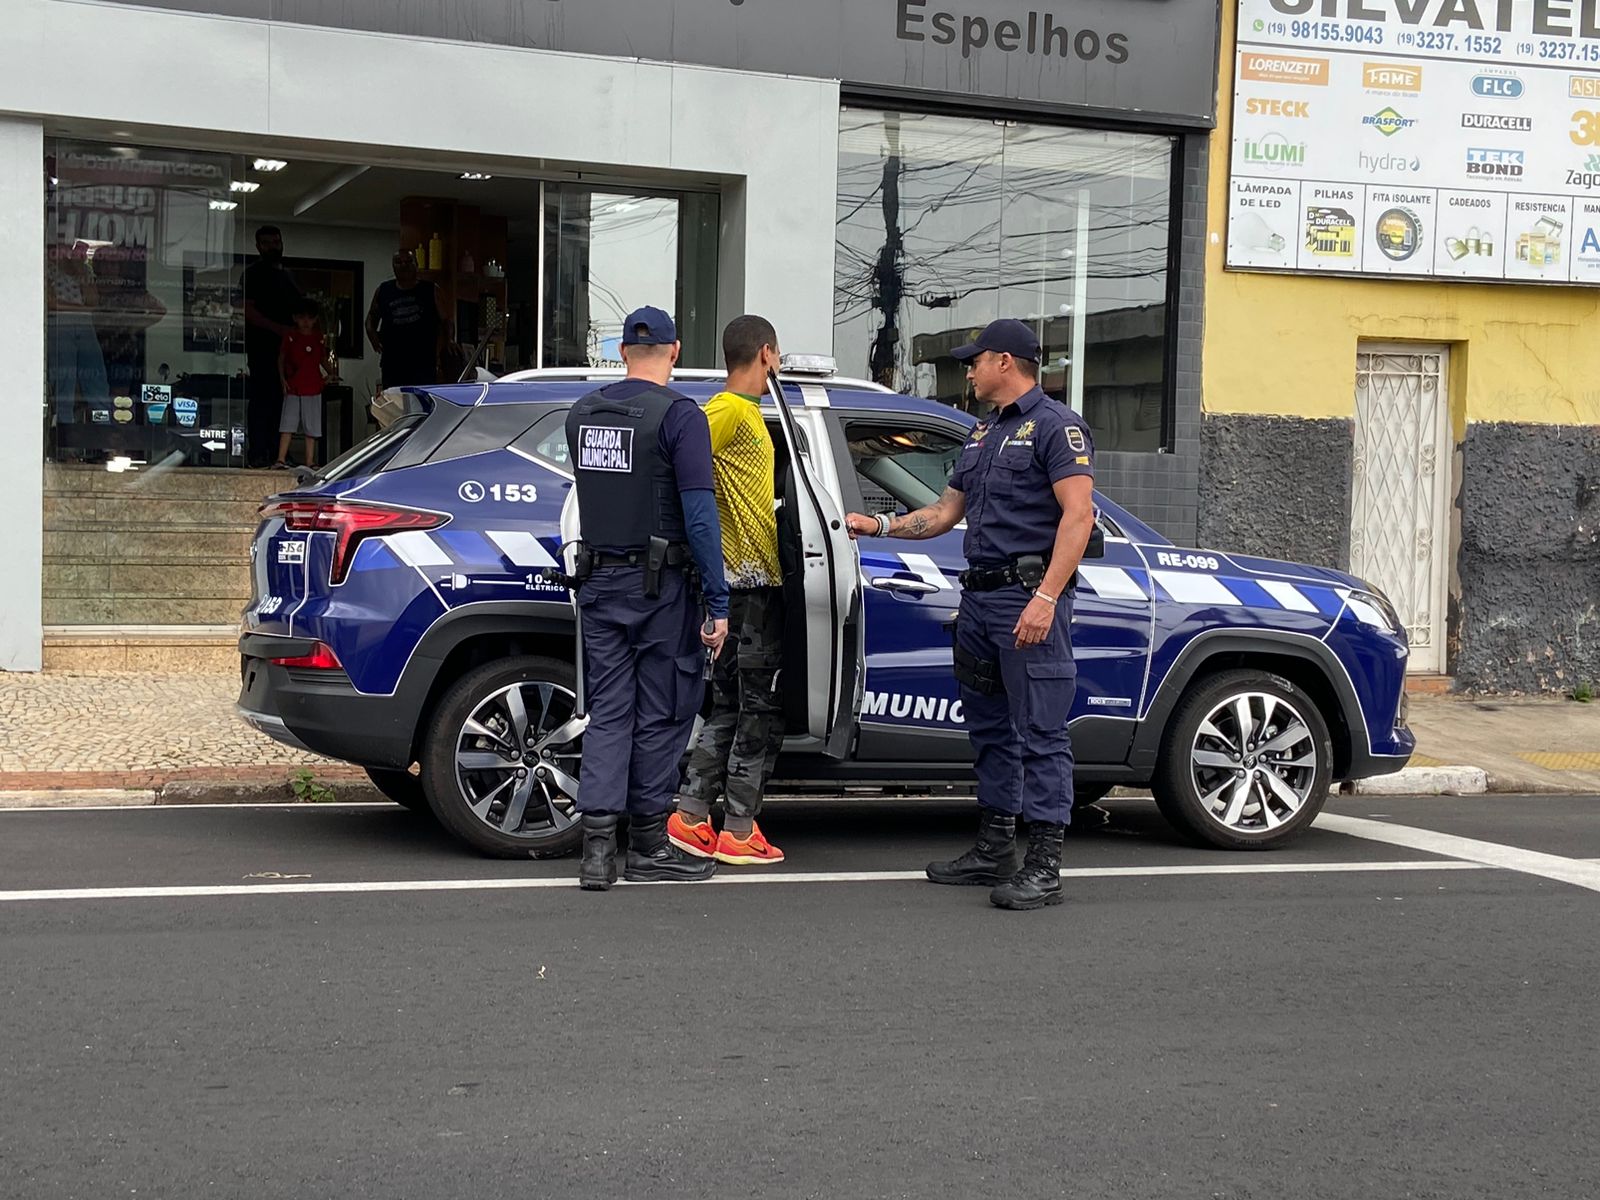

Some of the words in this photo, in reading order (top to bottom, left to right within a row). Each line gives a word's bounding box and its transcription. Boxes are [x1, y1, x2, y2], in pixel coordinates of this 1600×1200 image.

[896, 0, 1129, 64] Espelhos
[1267, 22, 1286, 37] (19)
[1291, 20, 1384, 45] 98155.9043
[1397, 32, 1415, 46] (19)
[1464, 34, 1502, 55] 1552
[1516, 42, 1534, 57] (19)
[1538, 41, 1600, 62] 3237.15
[1248, 57, 1321, 76] LORENZETTI
[1367, 68, 1418, 86] FAME
[1482, 79, 1513, 96] FLC
[1246, 97, 1310, 119] STECK
[1362, 116, 1415, 128] BRASFORT
[1463, 114, 1531, 131] DURACELL
[1569, 110, 1600, 146] 3
[1358, 151, 1407, 174] hydra
[1468, 150, 1524, 165] TEK
[1466, 162, 1523, 176] BOND
[1237, 183, 1292, 196] LÂMPADA
[1314, 189, 1354, 200] PILHAS
[1240, 198, 1256, 207] DE
[1259, 199, 1282, 209] LED
[1372, 192, 1390, 203] FITA
[1392, 193, 1431, 205] ISOLANTE
[1449, 197, 1492, 209] CADEADOS
[1515, 201, 1566, 214] RESISTENCIA
[1315, 218, 1351, 226] DURACELL
[177, 401, 196, 409] VISA
[178, 414, 196, 422] VISA
[200, 429, 226, 439] ENTRE
[585, 428, 622, 450] GUARDA
[582, 447, 628, 469] MUNICIPAL
[489, 483, 538, 503] 153
[1157, 552, 1219, 570] RE-099
[861, 691, 966, 724] MUNIC
